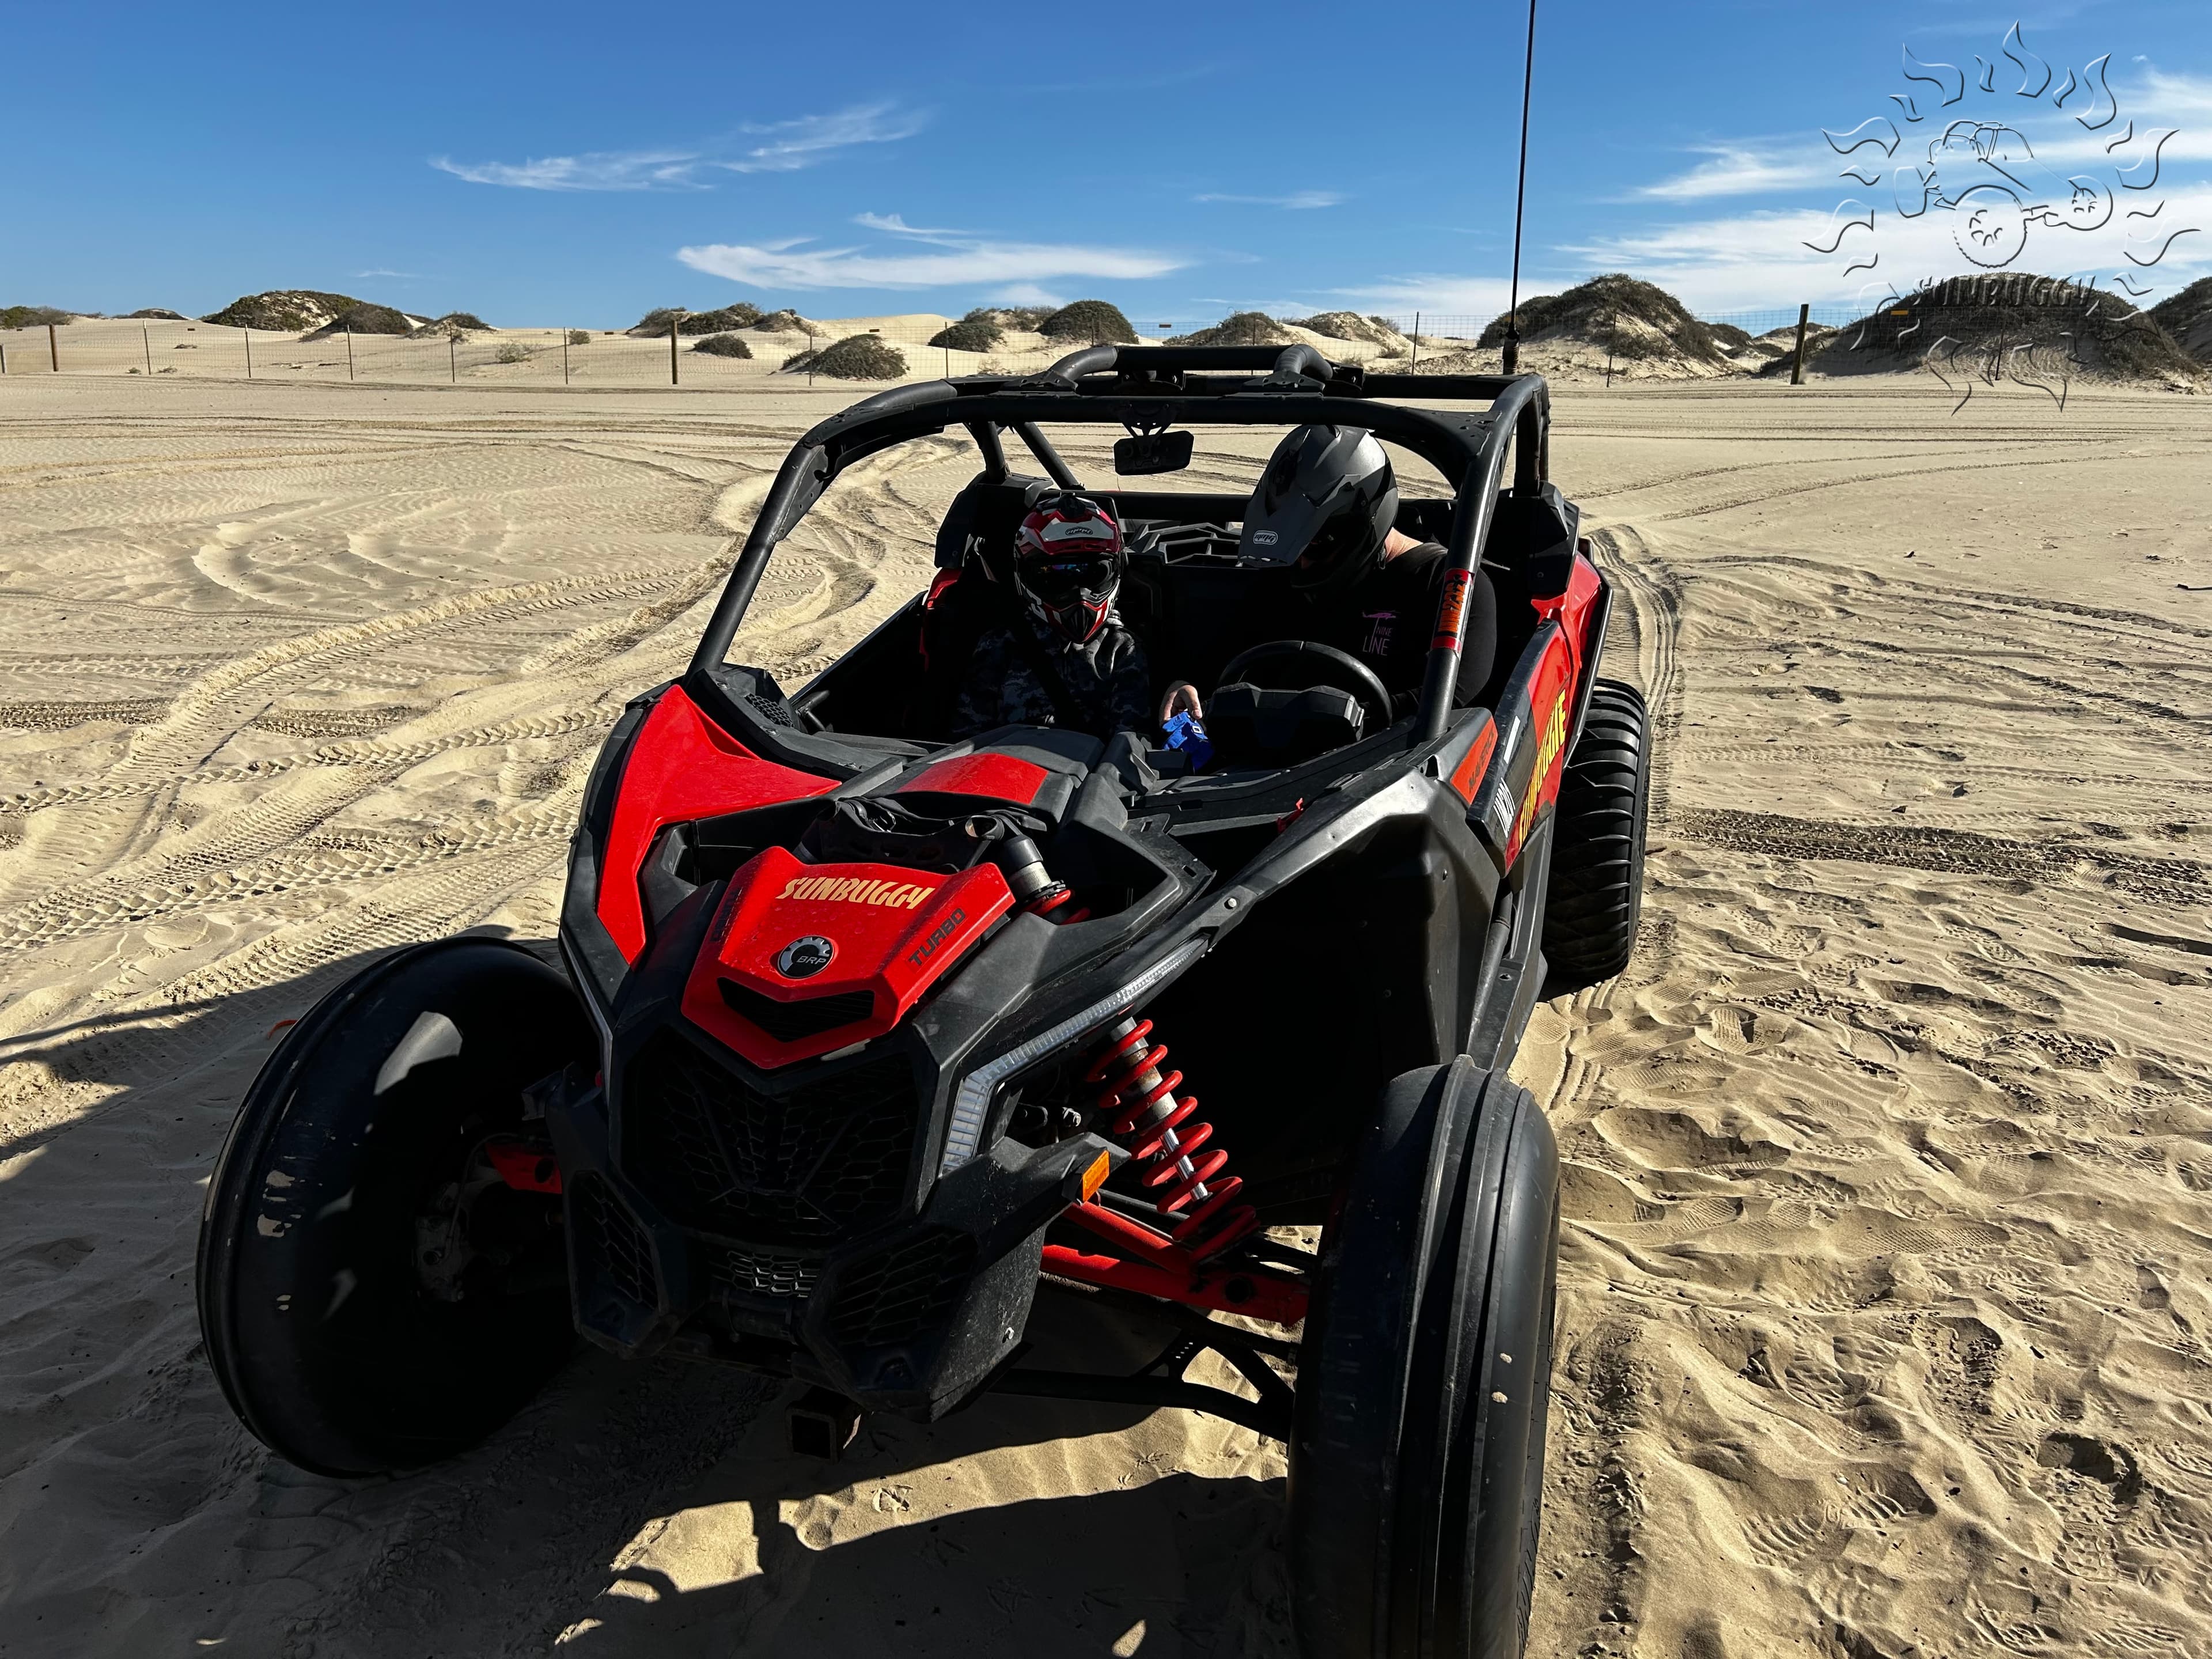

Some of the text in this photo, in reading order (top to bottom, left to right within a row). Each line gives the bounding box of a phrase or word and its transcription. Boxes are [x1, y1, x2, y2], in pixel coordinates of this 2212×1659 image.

[1376, 626, 1392, 637] NINE
[1362, 633, 1391, 656] LINE
[775, 877, 936, 910] SUNBUGGY
[908, 907, 967, 967] TURBO
[796, 955, 828, 965] BRP
